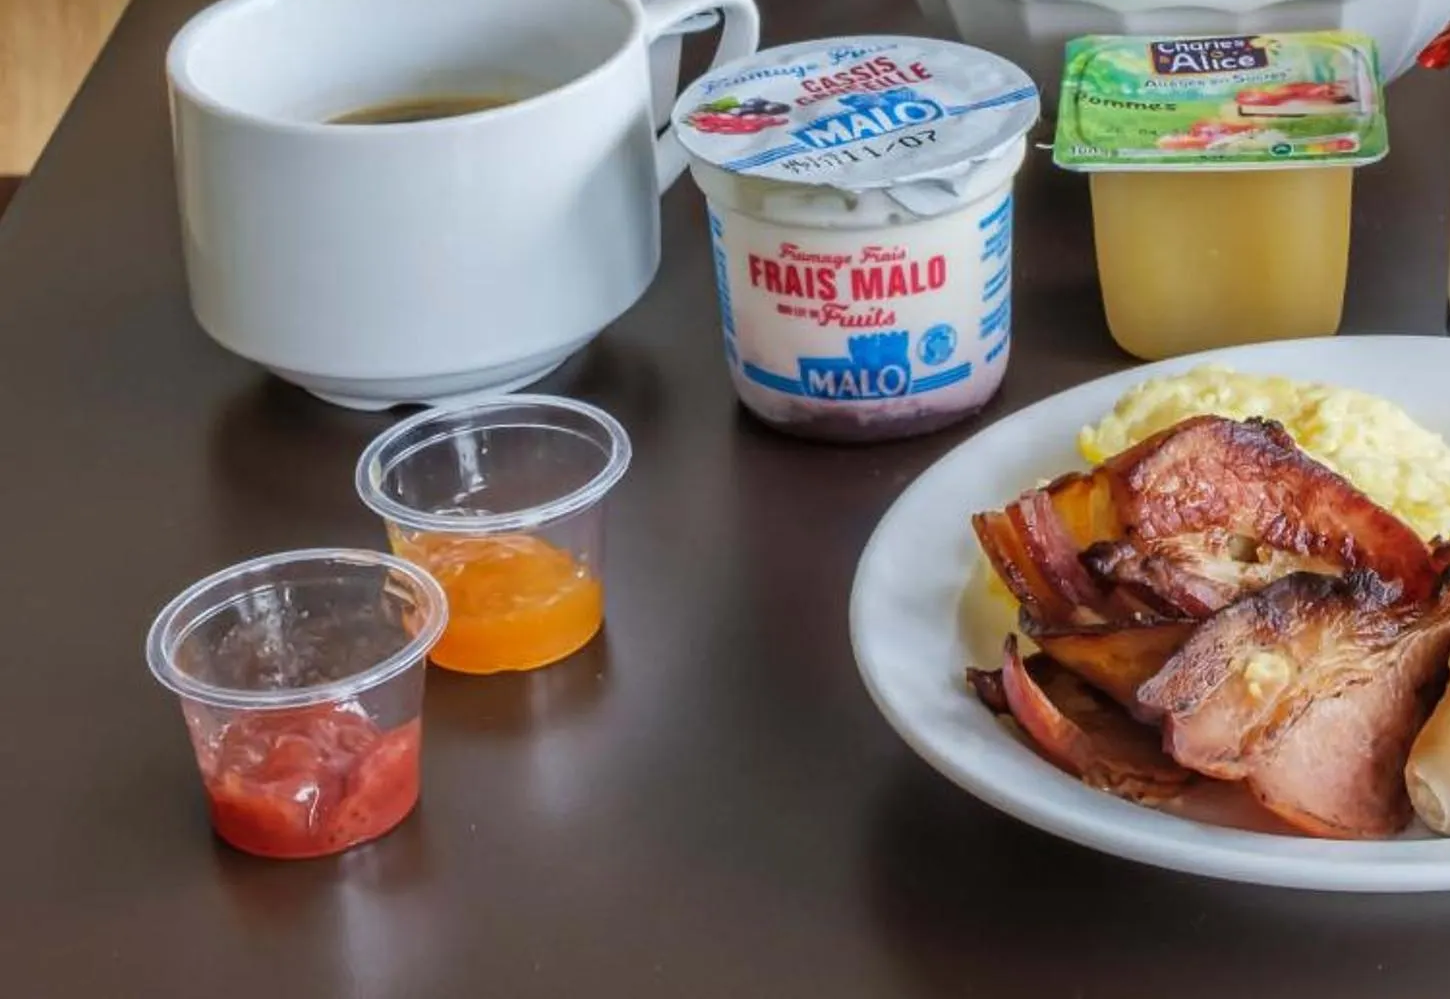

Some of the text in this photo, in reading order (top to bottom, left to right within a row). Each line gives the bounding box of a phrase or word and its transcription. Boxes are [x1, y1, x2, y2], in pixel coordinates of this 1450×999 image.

[1158, 39, 1244, 53] Charles
[801, 56, 897, 93] CASSIS
[1170, 53, 1256, 72] Alice
[804, 101, 938, 148] MALO
[779, 242, 907, 269] Fromage Frais
[748, 254, 947, 301] FRAIS MALO
[818, 302, 897, 328] Fruits
[807, 364, 906, 398] MALO
